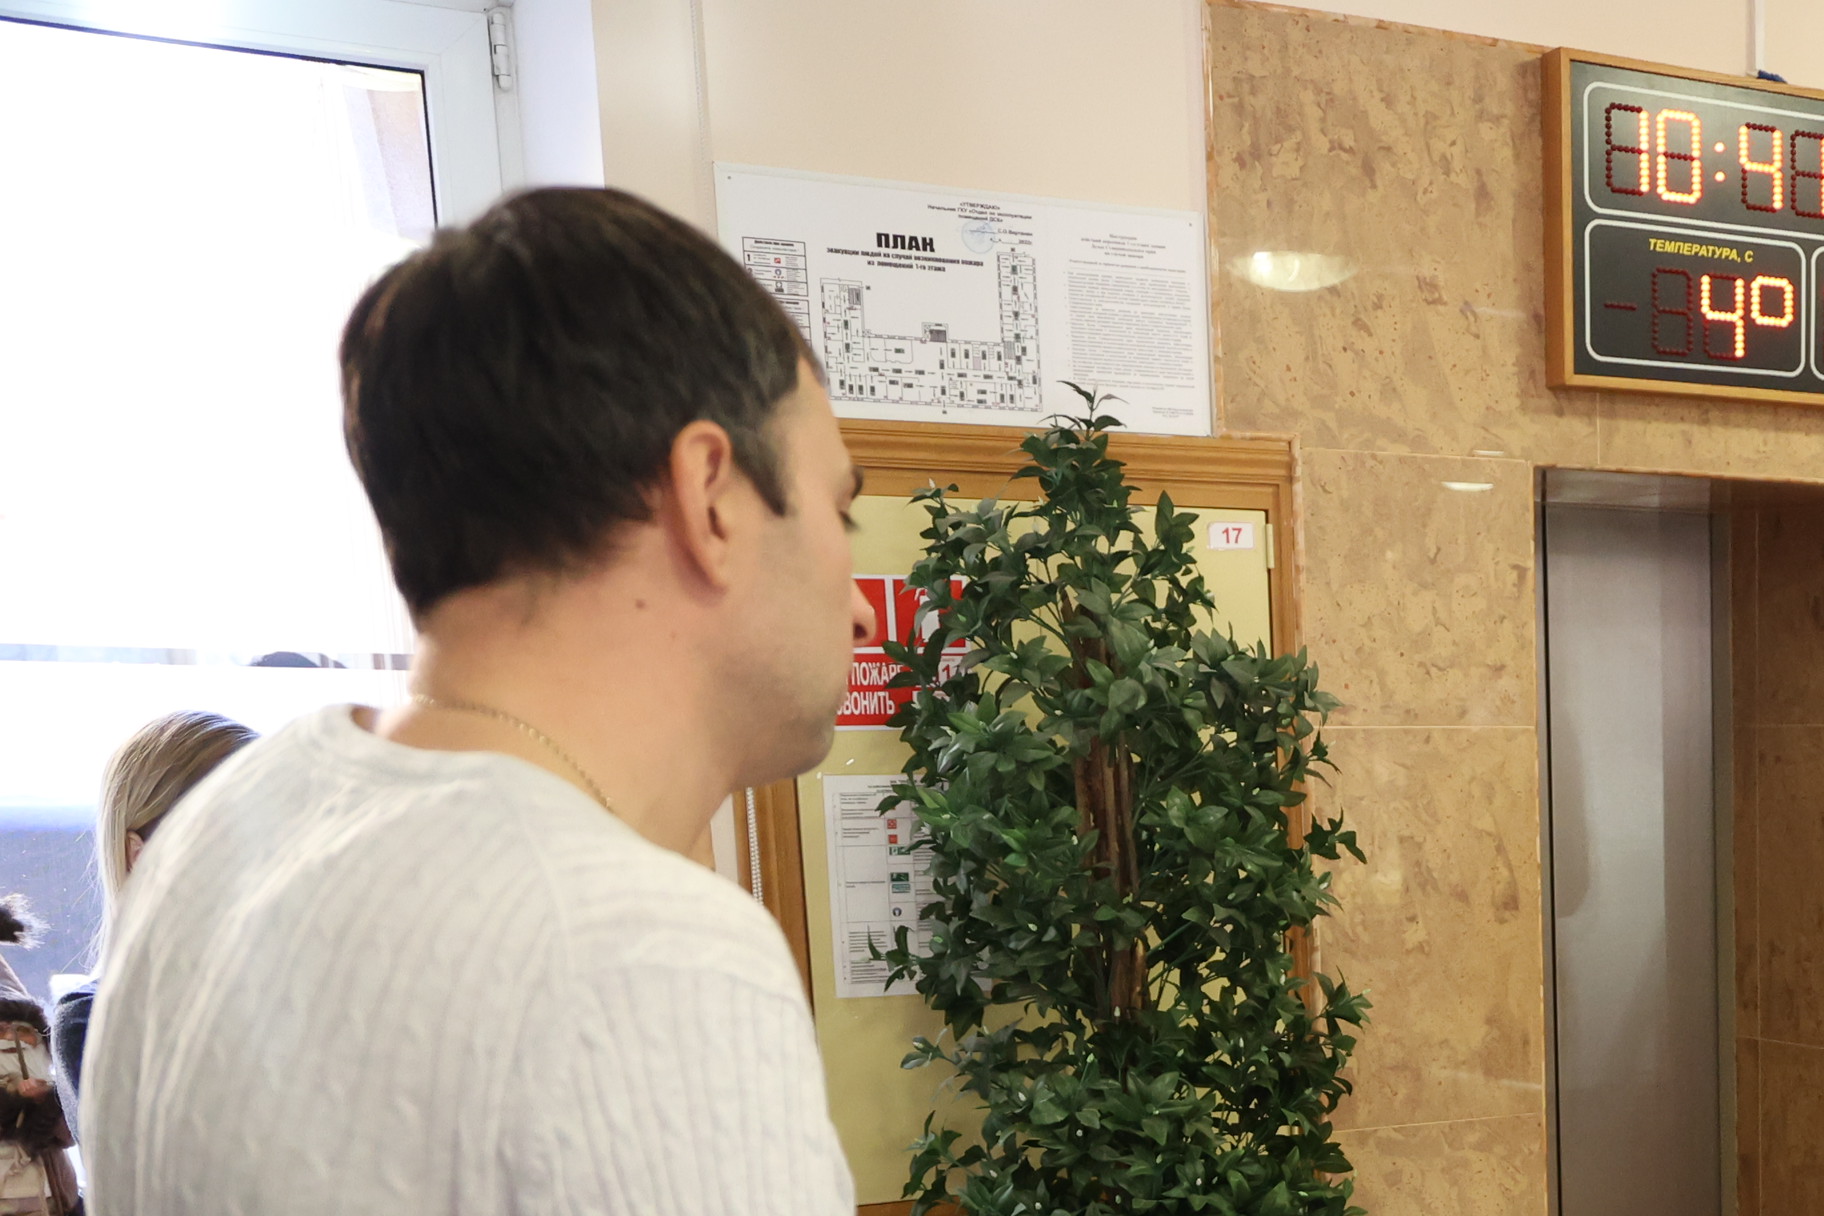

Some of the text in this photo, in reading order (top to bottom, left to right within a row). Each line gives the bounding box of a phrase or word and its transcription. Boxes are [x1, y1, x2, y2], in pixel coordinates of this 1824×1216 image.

[876, 232, 935, 253] ПЛАН
[1648, 238, 1743, 264] ТЕМПЕРАТУРА,
[1222, 527, 1243, 544] 17
[852, 661, 904, 686] ПОЖАР
